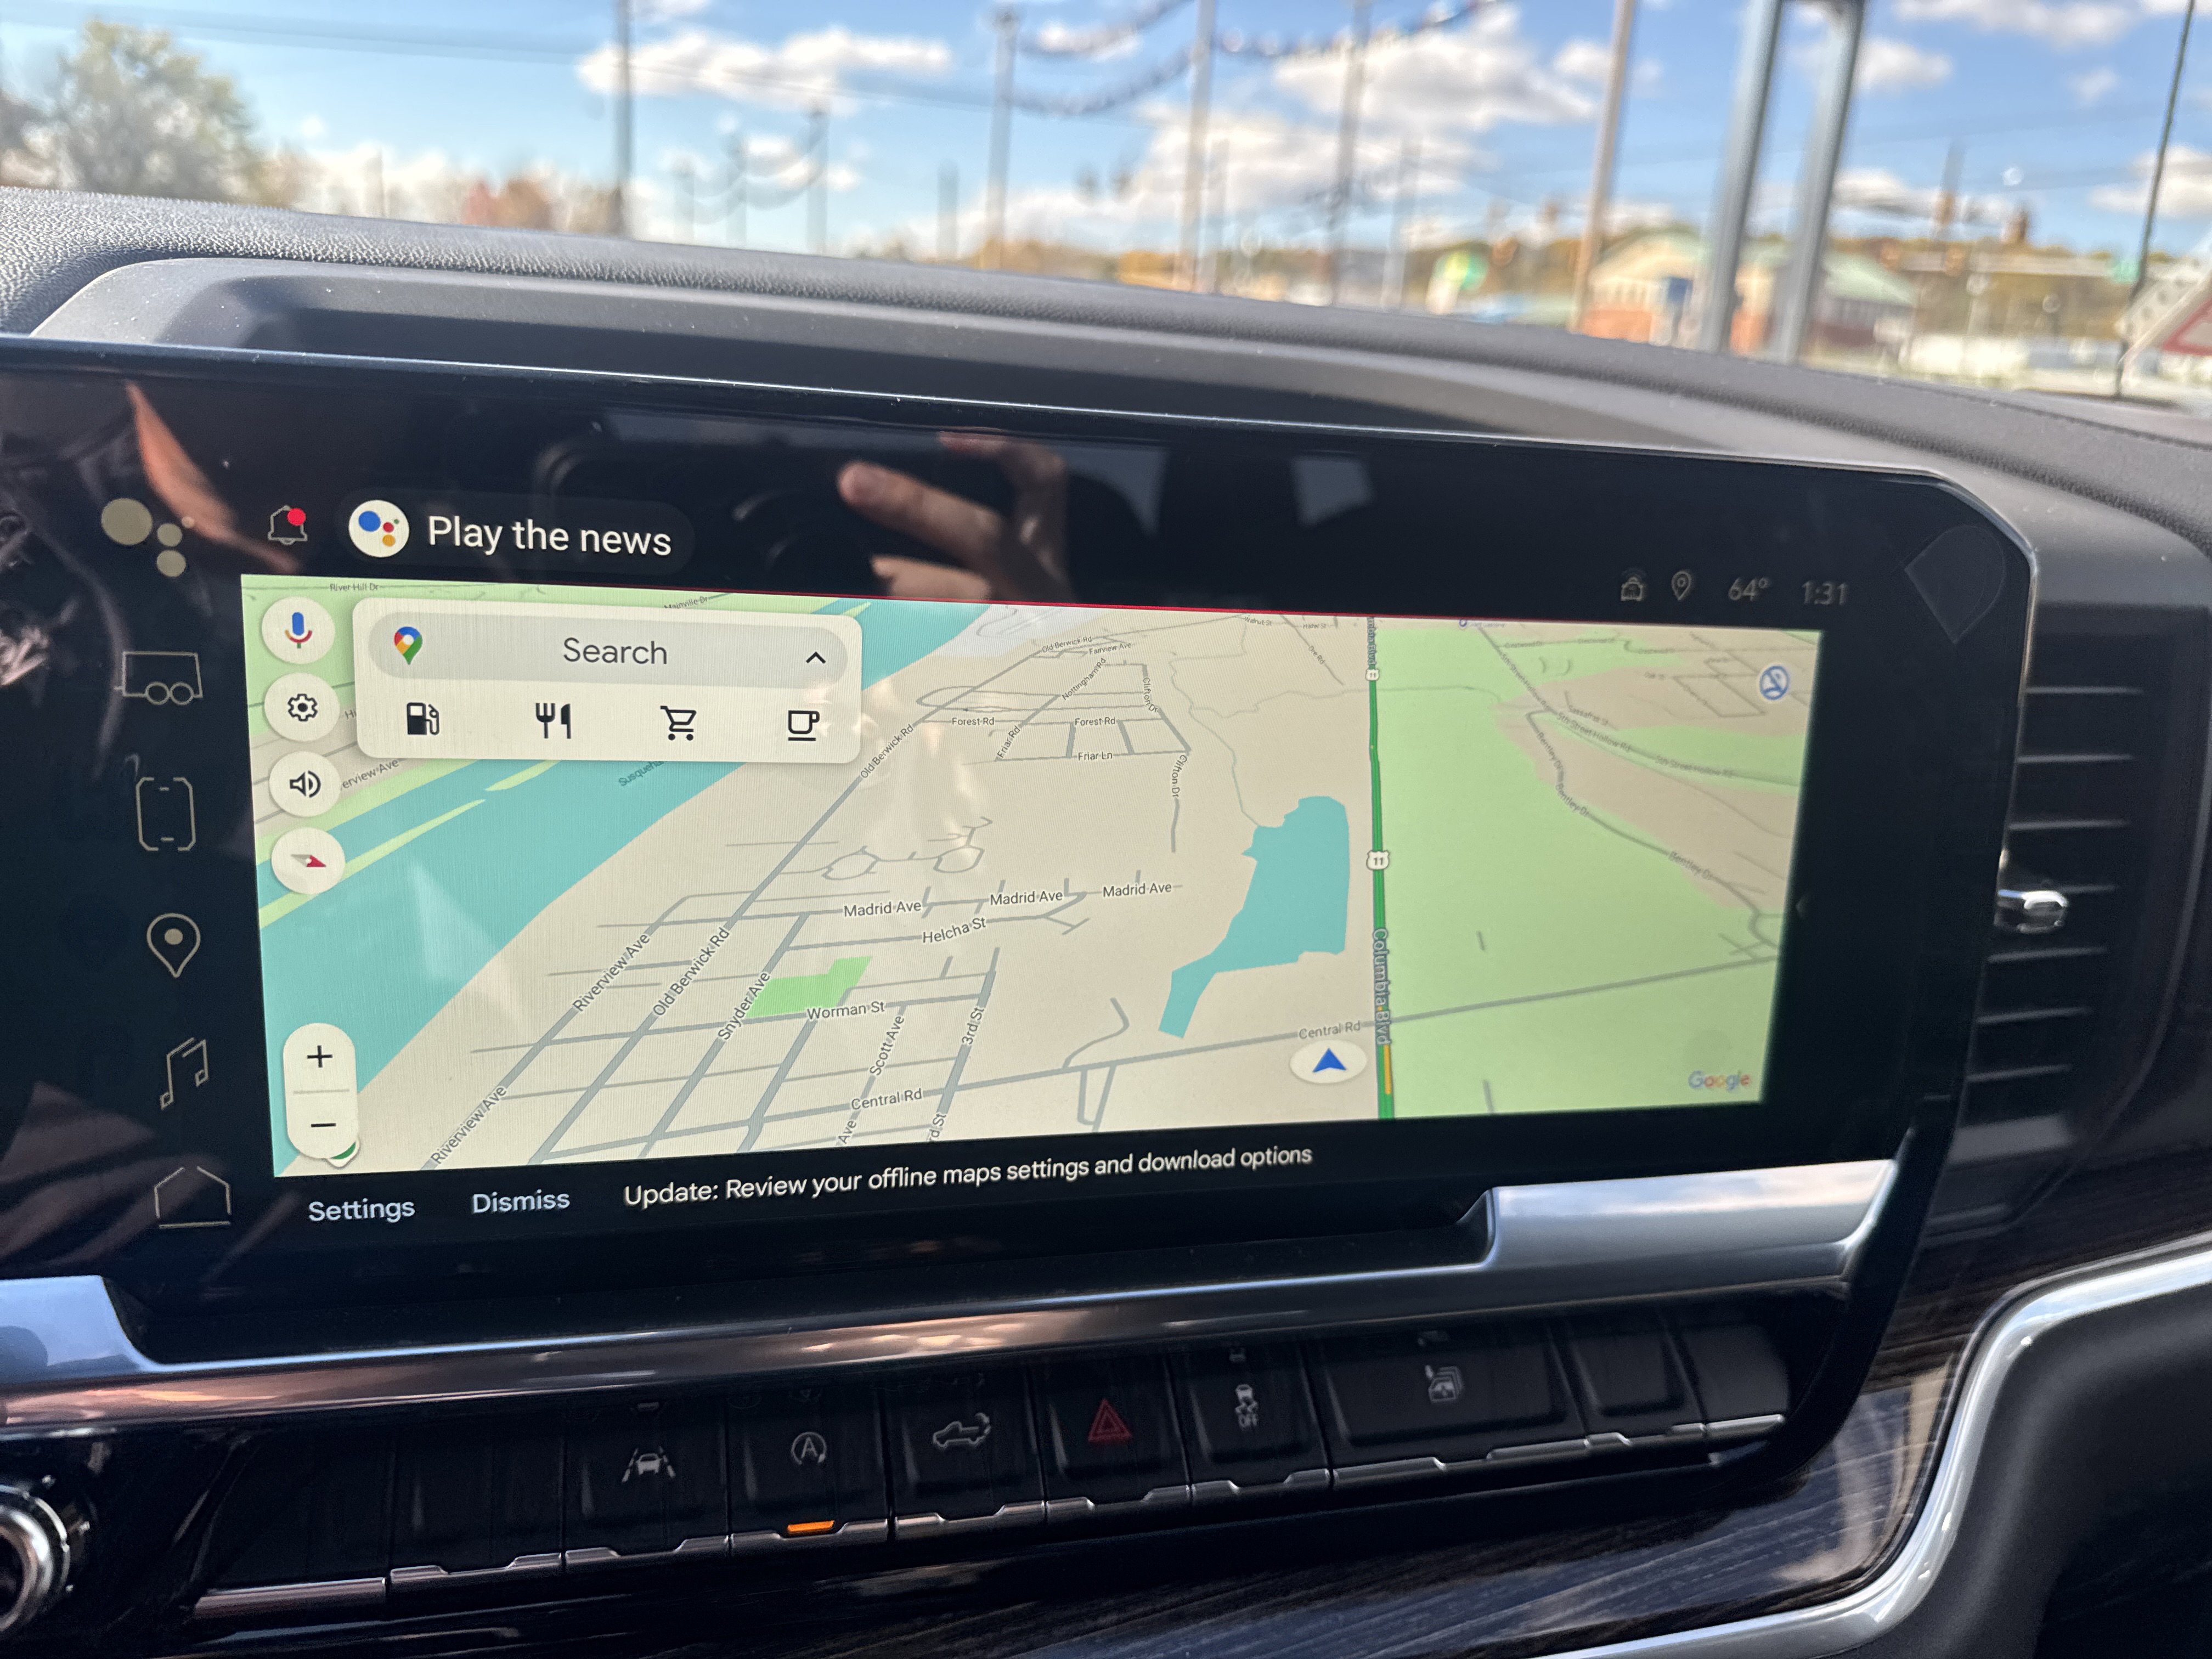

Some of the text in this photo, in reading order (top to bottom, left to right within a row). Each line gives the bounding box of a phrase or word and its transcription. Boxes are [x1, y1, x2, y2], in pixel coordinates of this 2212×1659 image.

[429, 516, 672, 556] Play the news
[330, 583, 379, 591] River Hill Dr
[1802, 581, 1847, 604] 1:31
[563, 638, 667, 664] Search
[1042, 644, 1053, 653] Old
[1054, 637, 1081, 649] Berwick
[1089, 646, 1117, 654] Fairview
[1308, 645, 1325, 664] Ore Rd
[1367, 644, 1376, 665] Blvd
[1097, 657, 1106, 669] Rd
[1143, 677, 1159, 713] Clifton Dr
[952, 716, 995, 726] Forest Rd
[1075, 716, 1116, 726] Forest Rd
[997, 725, 1021, 758] Friar Rd
[1570, 719, 1592, 736] Street
[1593, 731, 1619, 748] Hollow
[860, 724, 915, 779] Old Berwick Rd
[1078, 751, 1113, 761] Friar Ln
[340, 759, 399, 791] erview Ave
[1171, 754, 1188, 798] Clifton Dr
[1373, 857, 1384, 866] 11
[990, 890, 1063, 906] Madrid Ave
[1103, 881, 1172, 898] Madrid Ave
[844, 900, 922, 917] Madrid Ave
[922, 917, 987, 944] Helcha St
[572, 933, 651, 1012] Riverview Ave
[652, 926, 730, 1017] Old Berwick Rd
[1373, 928, 1392, 1045] Columbia Blvd
[717, 972, 770, 1041] Snyder Ave
[807, 1000, 885, 1020] Worman St
[961, 1006, 985, 1046] 3rd St
[1299, 1020, 1361, 1040] Central Rd
[869, 1014, 905, 1076] Scott Ave
[1688, 1070, 1751, 1093] Google
[851, 1087, 923, 1111] Central Rd
[430, 1085, 507, 1165] Riverview Ave
[838, 1119, 857, 1146] Ave
[932, 1112, 947, 1132] St
[625, 1144, 1313, 1210] Update: Review your offline maps settings and download options
[308, 1198, 415, 1223] Settings
[472, 1190, 571, 1214] Dismiss
